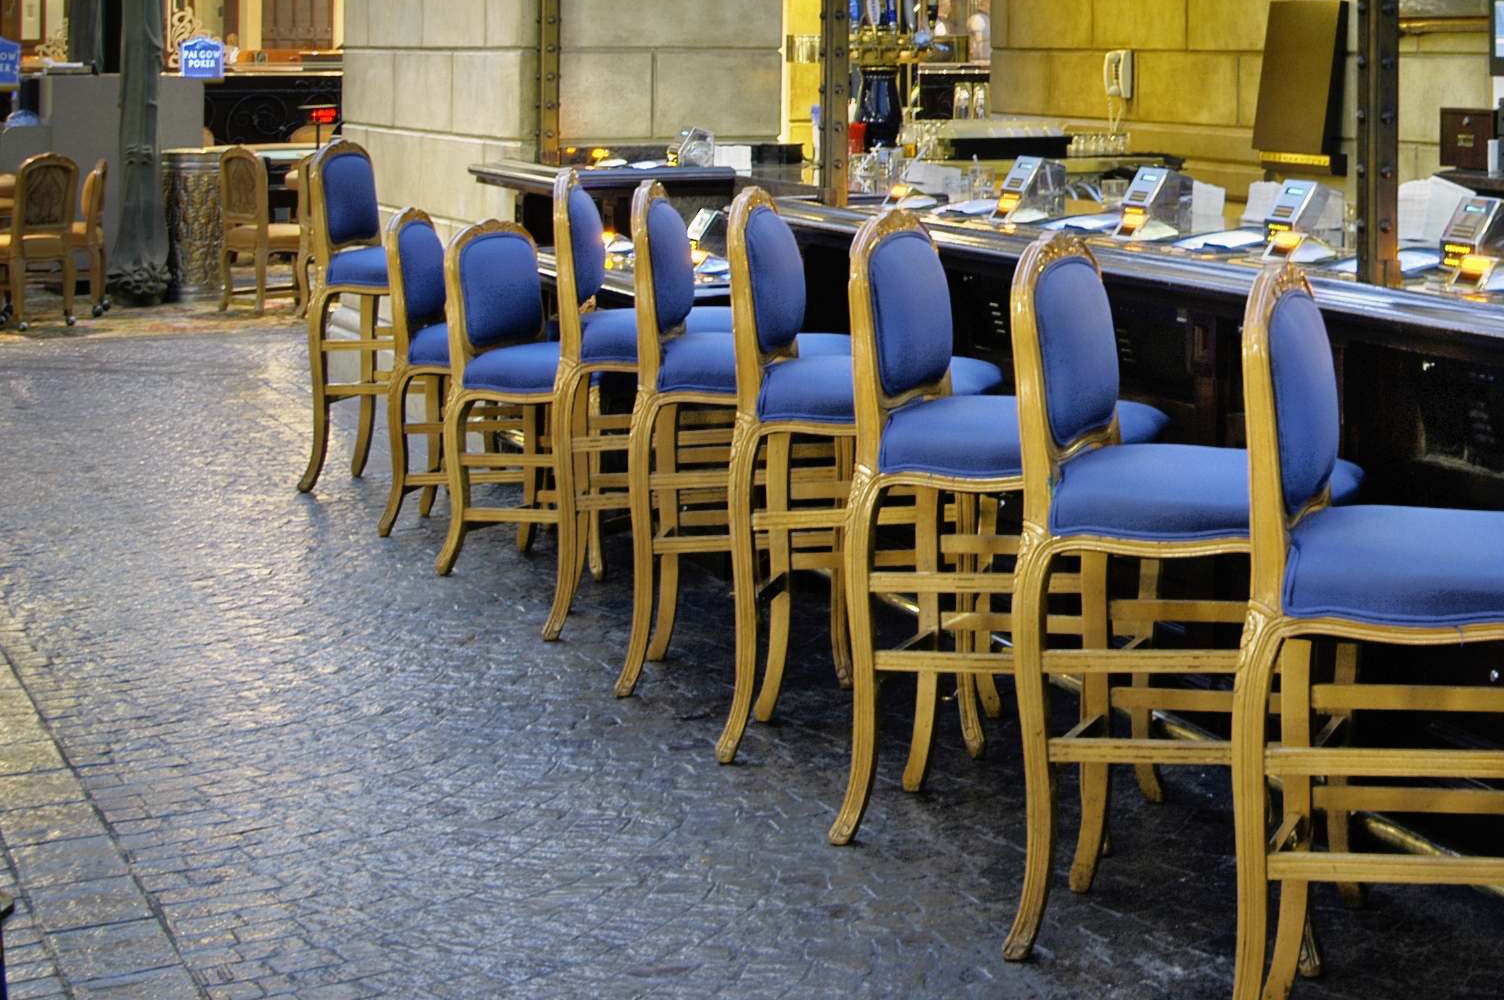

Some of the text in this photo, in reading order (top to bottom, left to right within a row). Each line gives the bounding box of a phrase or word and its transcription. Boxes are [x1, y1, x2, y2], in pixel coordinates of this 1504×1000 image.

[183, 49, 220, 59] PAI GOW
[188, 59, 216, 69] POKER
